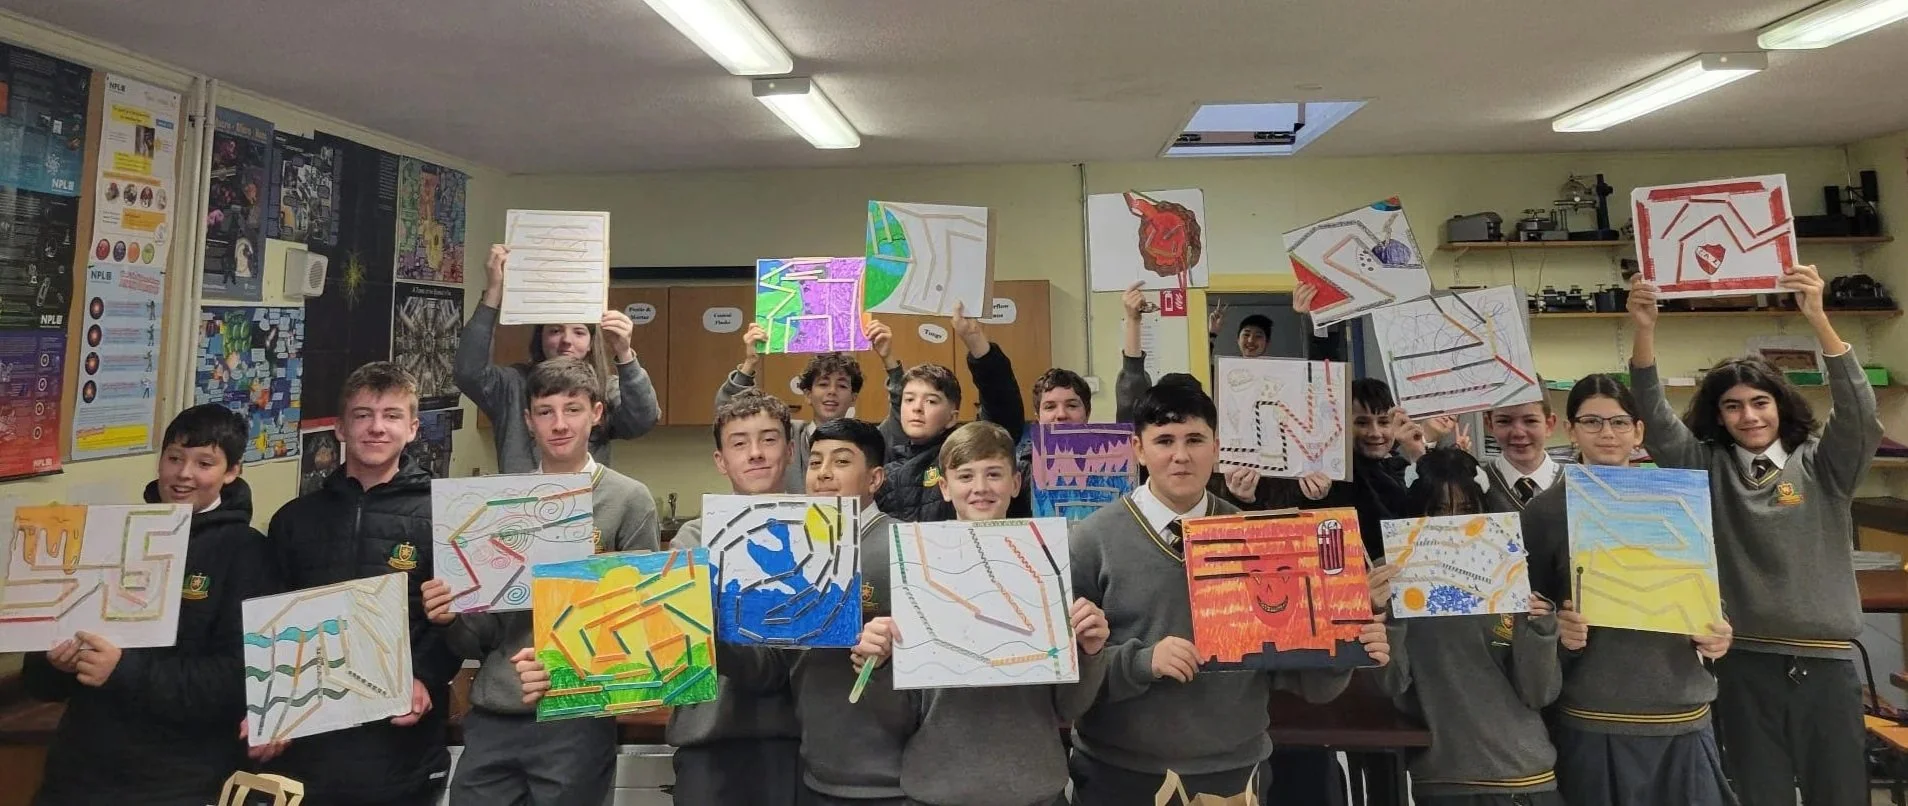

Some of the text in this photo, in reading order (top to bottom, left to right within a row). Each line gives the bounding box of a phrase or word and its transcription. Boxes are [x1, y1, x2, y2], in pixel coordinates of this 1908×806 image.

[51, 178, 68, 190] NPL
[91, 270, 105, 280] NPL
[40, 314, 57, 325] NPL
